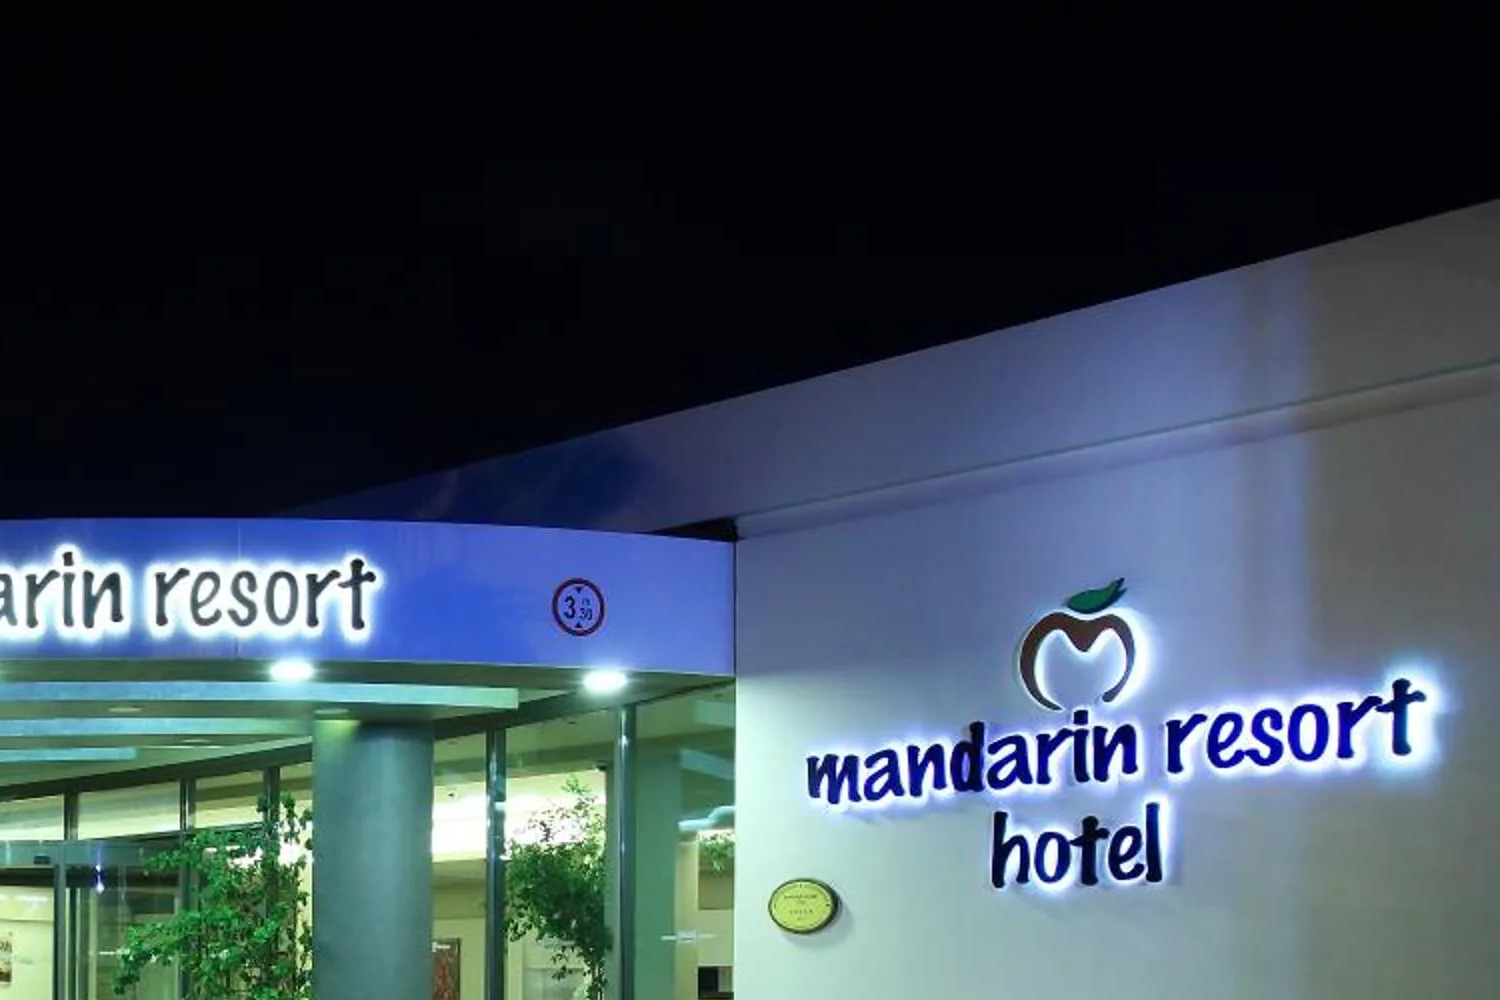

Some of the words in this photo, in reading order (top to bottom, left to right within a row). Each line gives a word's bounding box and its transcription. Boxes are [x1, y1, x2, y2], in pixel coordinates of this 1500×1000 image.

[153, 557, 377, 630] resort
[806, 710, 1138, 804] mandarin
[1167, 677, 1426, 774] resort
[992, 802, 1164, 889] hotel
